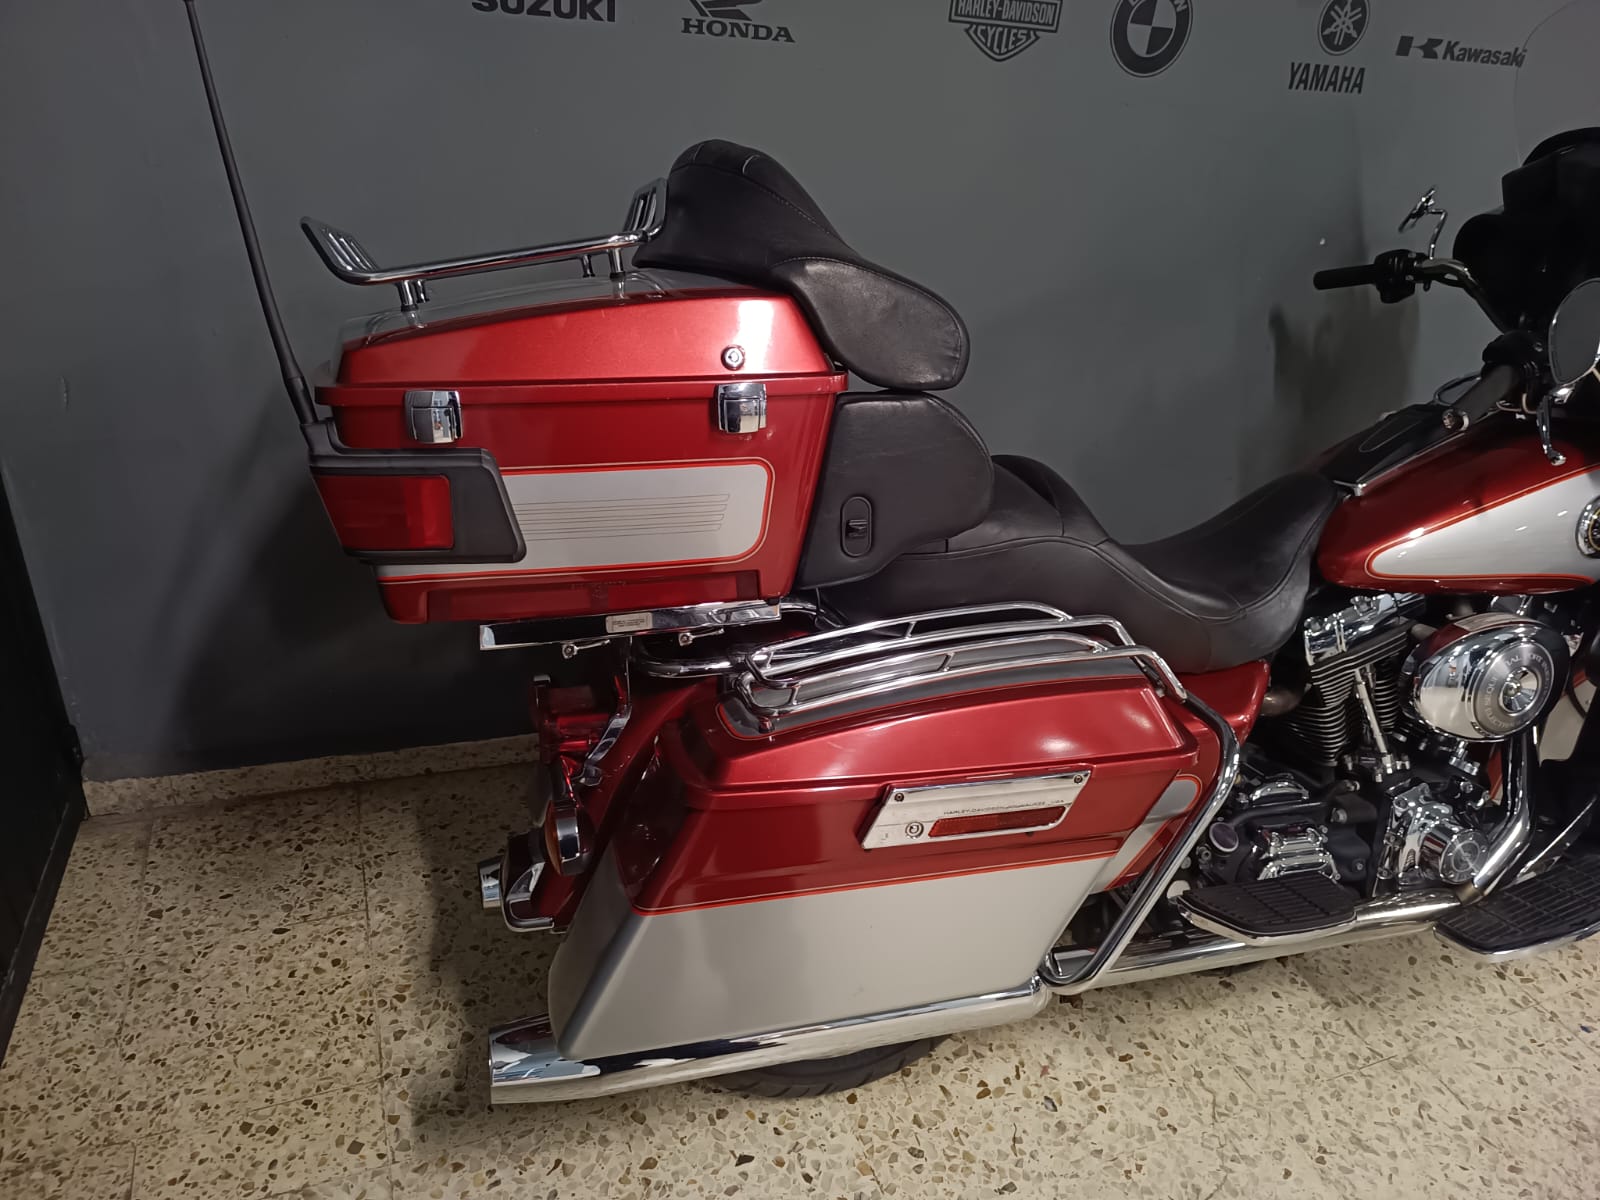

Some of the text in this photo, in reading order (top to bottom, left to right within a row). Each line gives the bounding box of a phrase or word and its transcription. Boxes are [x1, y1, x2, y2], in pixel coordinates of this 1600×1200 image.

[957, 0, 1055, 25] HARLEY-DAVIDSON
[681, 18, 796, 43] HONDA
[976, 25, 1028, 54] CYCLES
[1442, 40, 1528, 68] Kawasaki
[1288, 62, 1366, 94] YAMAHA
